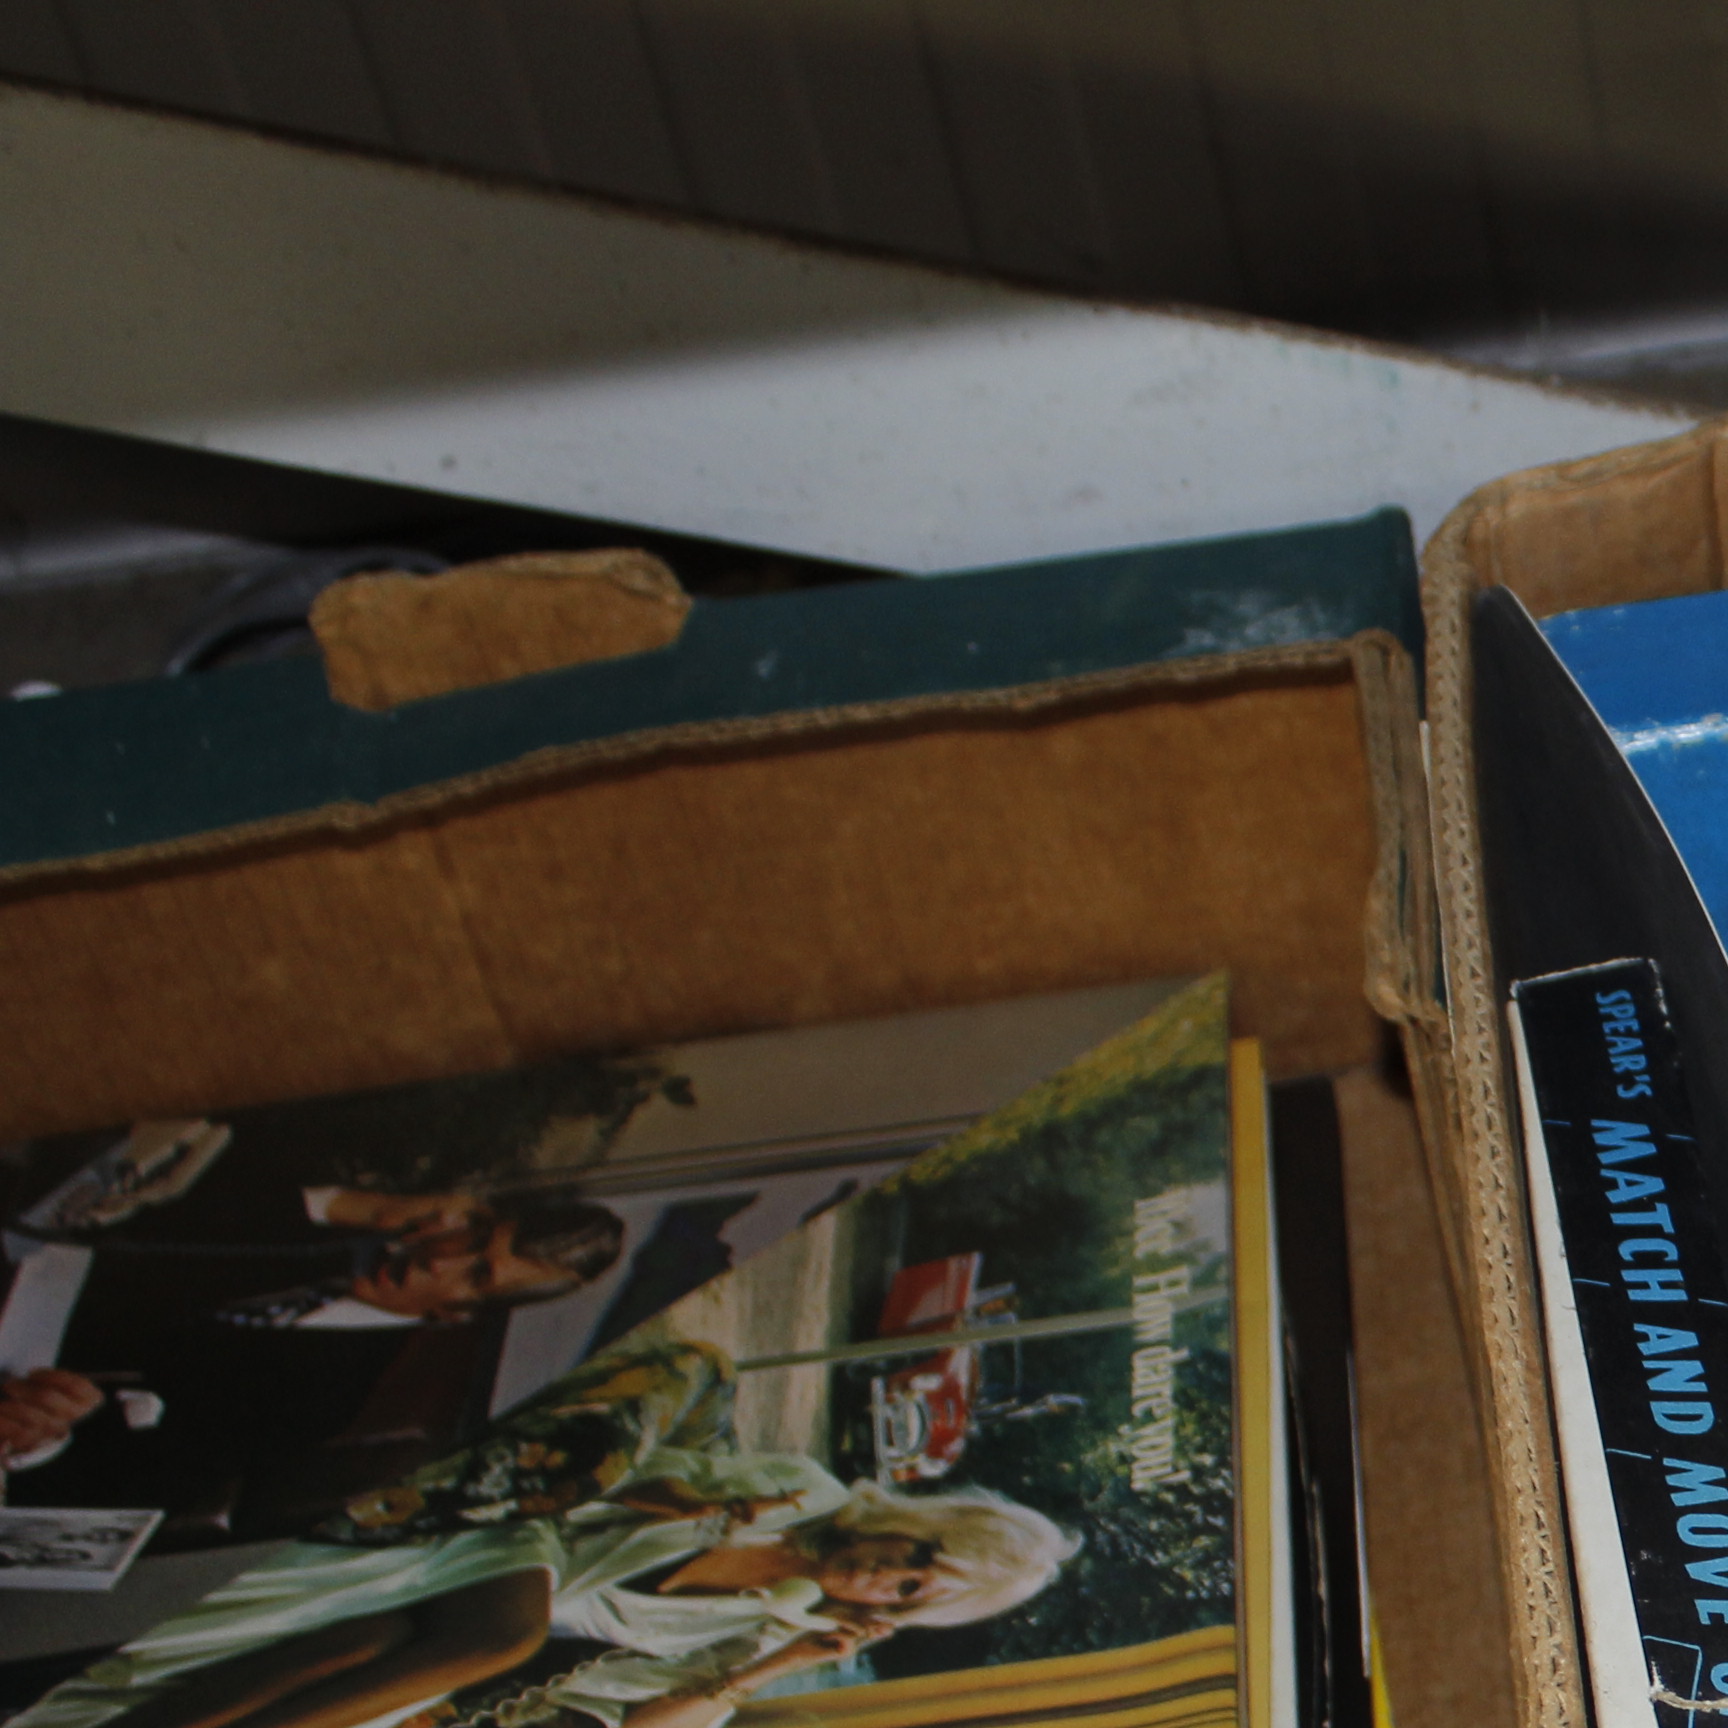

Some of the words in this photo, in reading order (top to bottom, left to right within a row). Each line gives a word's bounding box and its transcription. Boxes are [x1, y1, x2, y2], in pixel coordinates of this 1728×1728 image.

[1595, 989, 1653, 1100] SPEAR'S
[1590, 1117, 1690, 1304] MATCH
[1132, 1266, 1188, 1340] How
[1131, 1346, 1190, 1416] dare
[1632, 1321, 1715, 1436] AND
